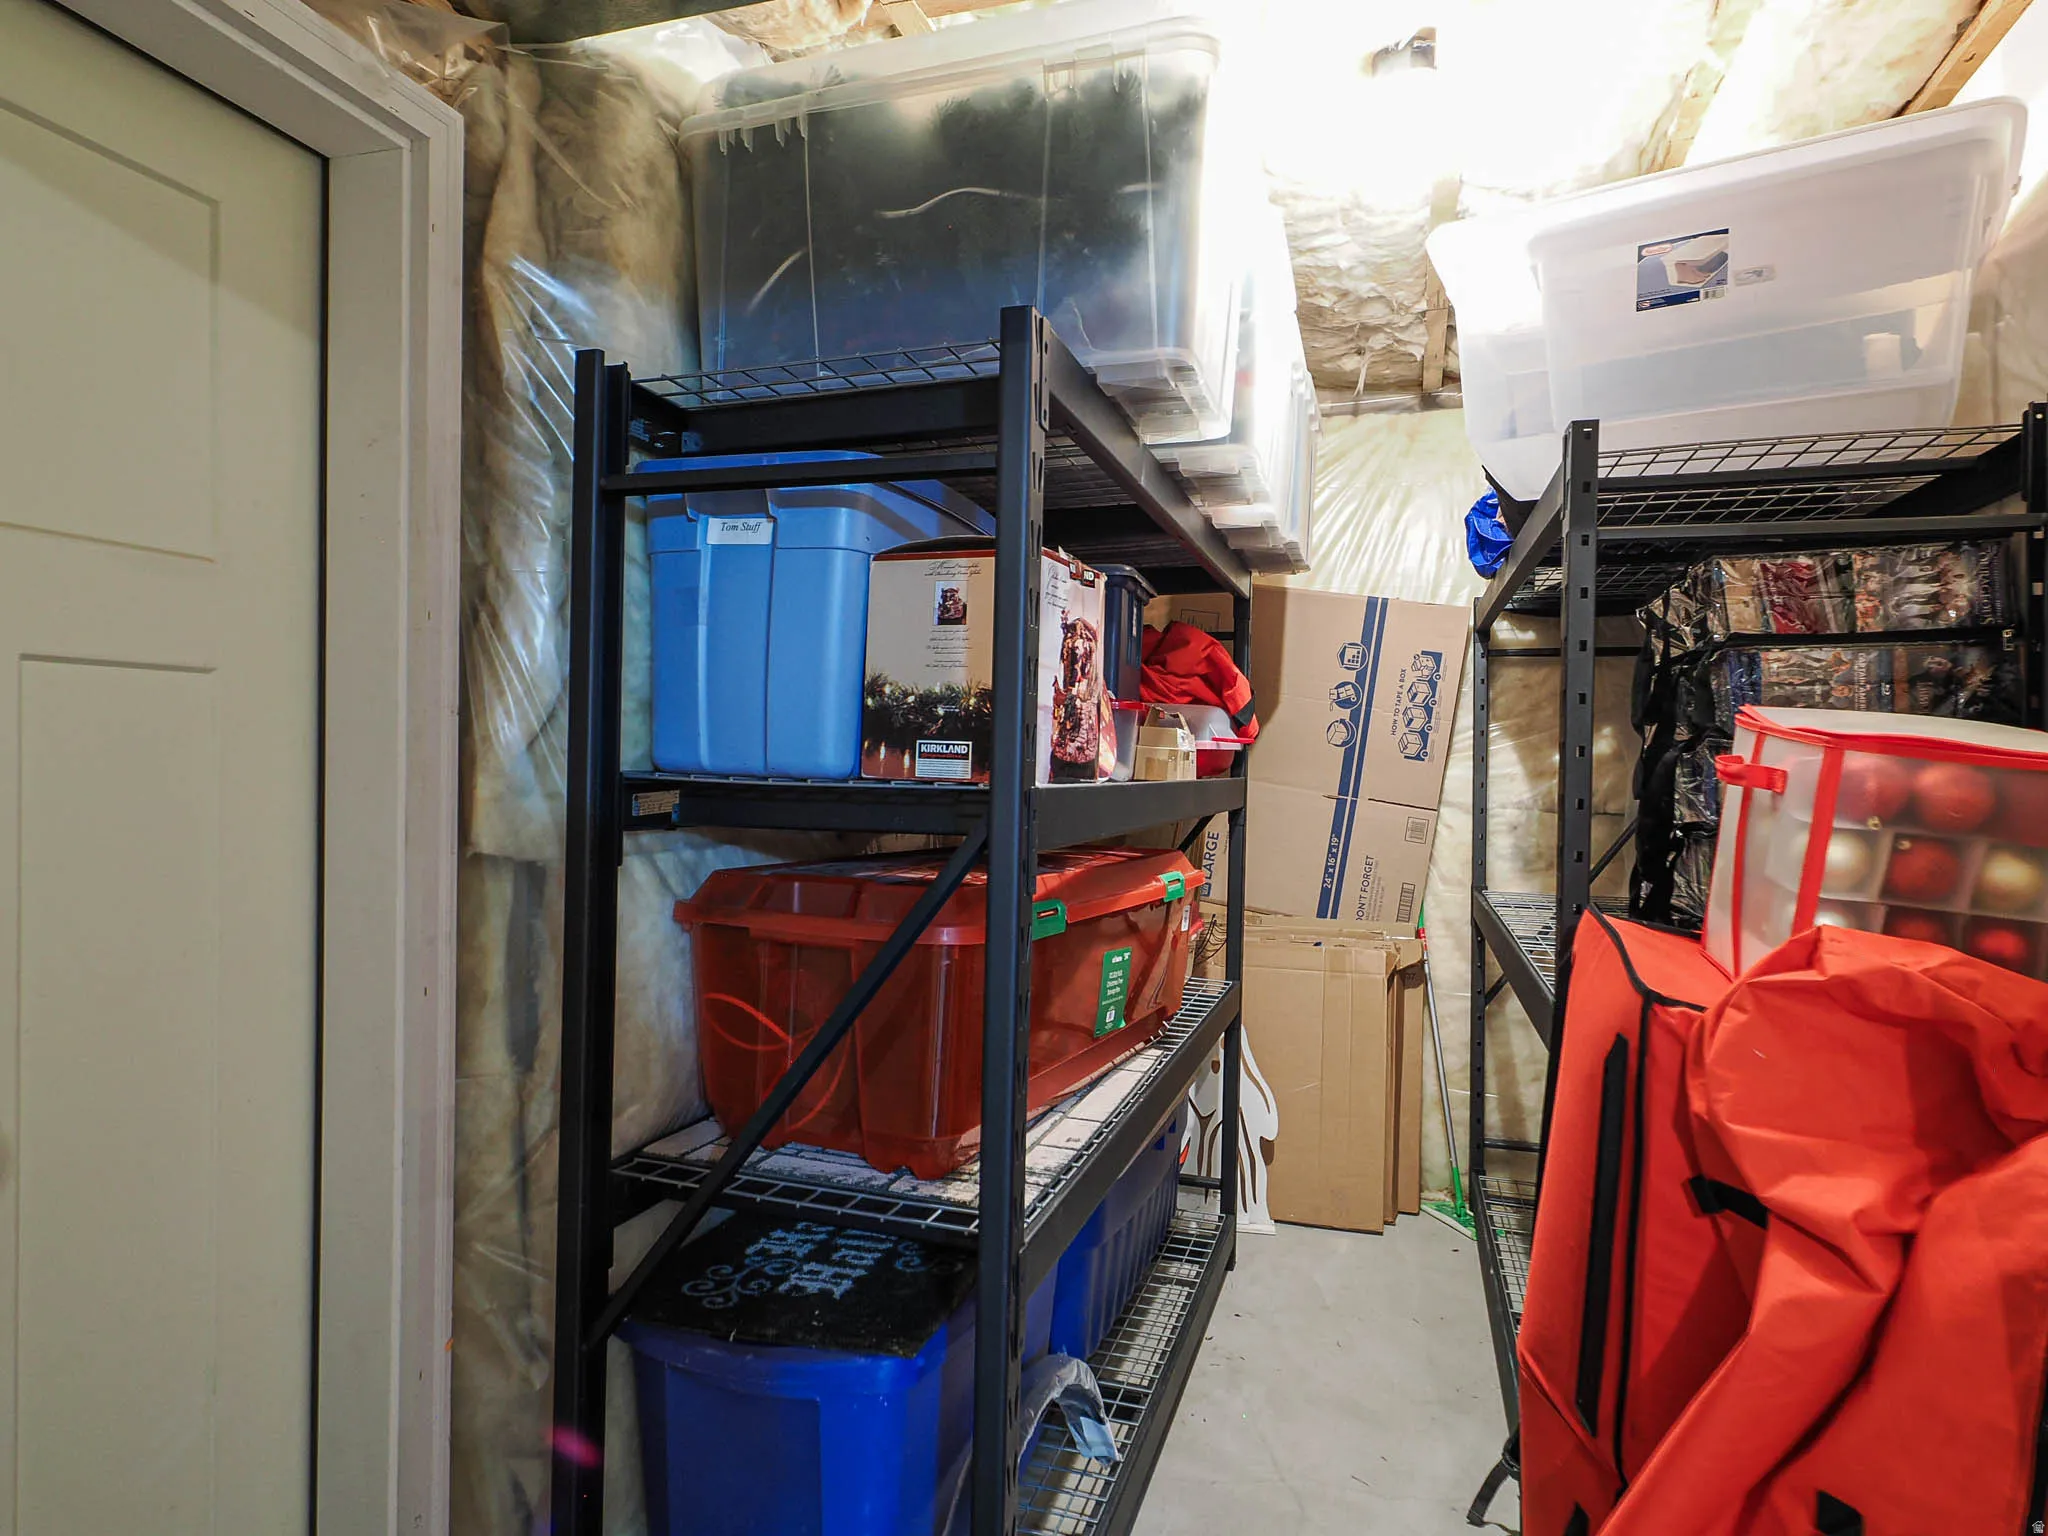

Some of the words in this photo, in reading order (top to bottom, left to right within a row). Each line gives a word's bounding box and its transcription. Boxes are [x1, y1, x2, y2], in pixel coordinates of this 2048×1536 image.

[720, 521, 739, 532] Tom
[740, 521, 763, 534] Stuff
[1399, 668, 1407, 682] BOX
[1395, 691, 1403, 707] TAPE
[1393, 708, 1400, 718] TO
[1390, 718, 1398, 736] HOW
[920, 743, 968, 754] KIRKLAND
[1330, 833, 1340, 846] 19"
[1202, 831, 1220, 880] LARGE
[1327, 853, 1336, 866] 16"
[1323, 873, 1332, 889] 24"
[1360, 855, 1375, 893] FORGET
